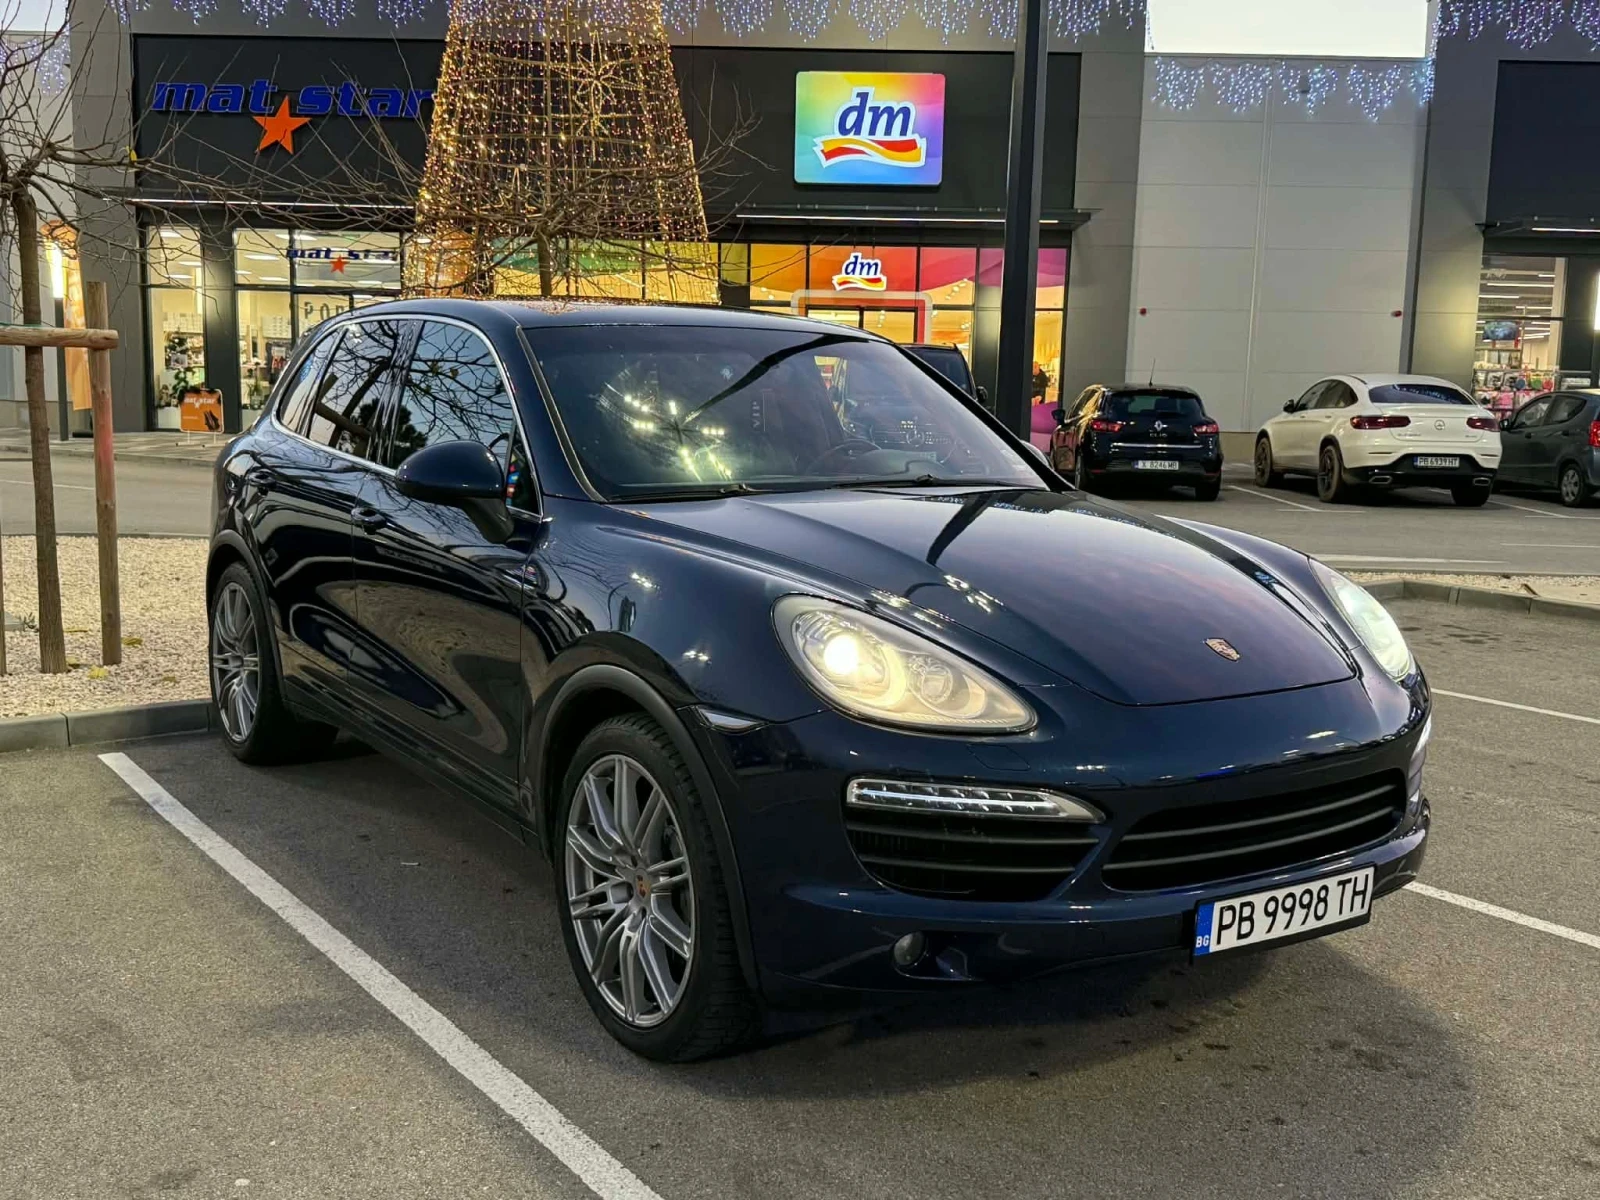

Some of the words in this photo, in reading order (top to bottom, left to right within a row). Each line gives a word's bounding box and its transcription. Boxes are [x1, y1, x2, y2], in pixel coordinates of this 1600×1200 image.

[150, 79, 277, 114] mat
[296, 81, 434, 118] star
[838, 92, 911, 136] dm
[286, 248, 331, 259] mat
[844, 255, 879, 276] dm
[1216, 901, 1255, 945] PB
[1263, 884, 1329, 934] 9998
[1336, 874, 1369, 915] TH
[1196, 935, 1210, 948] BG
